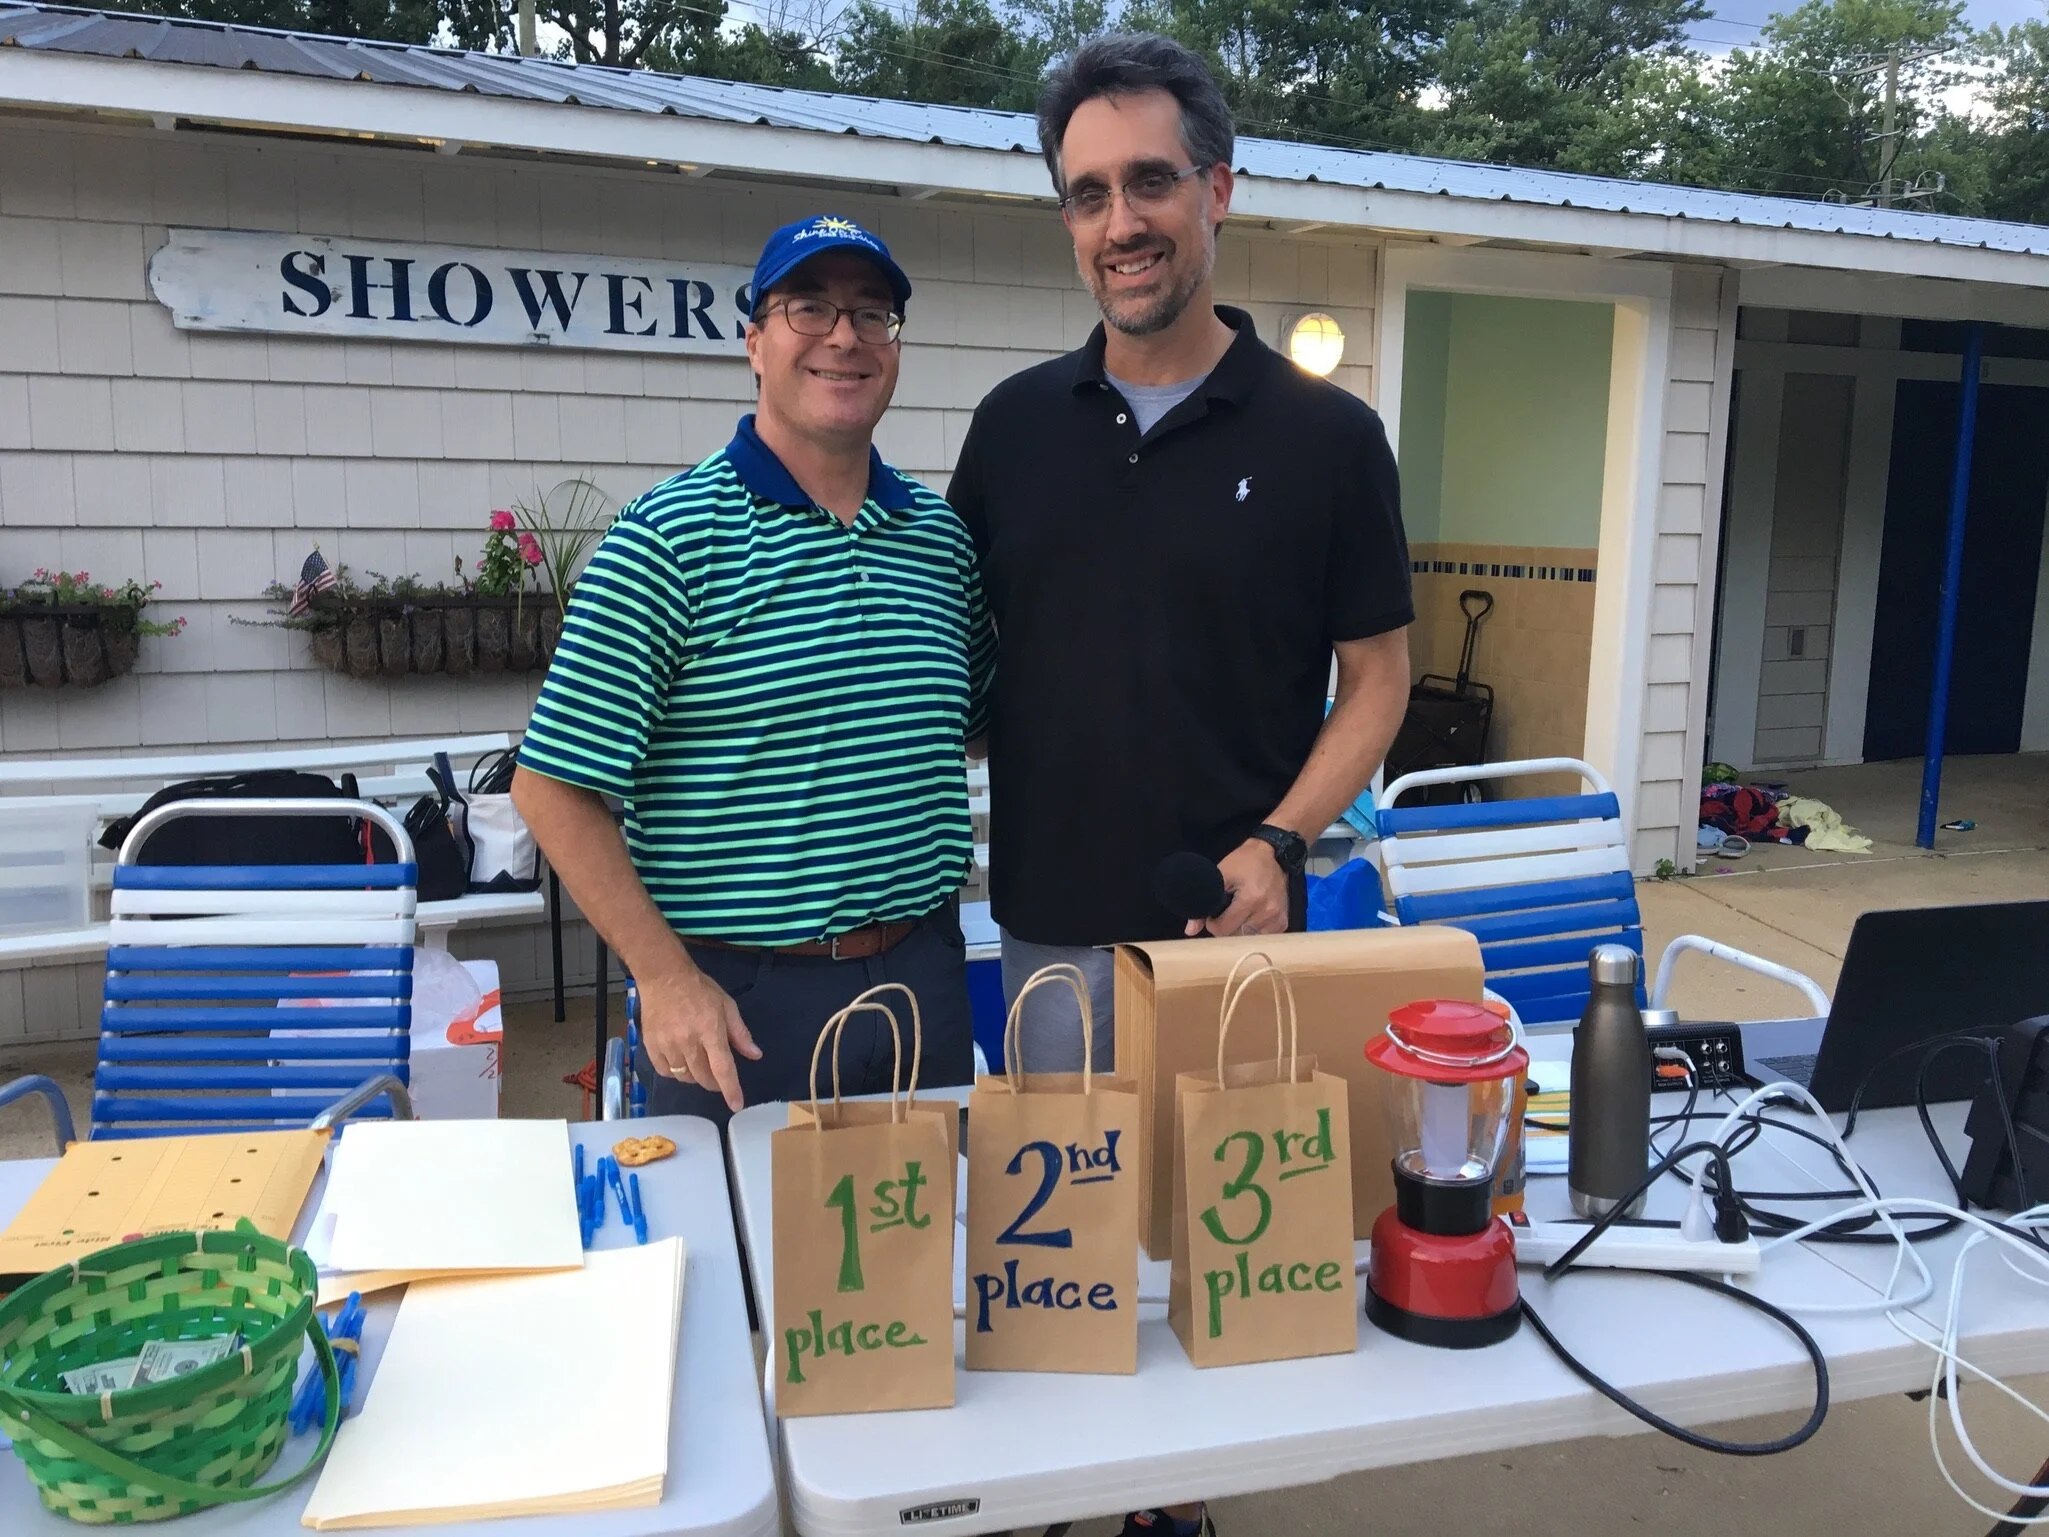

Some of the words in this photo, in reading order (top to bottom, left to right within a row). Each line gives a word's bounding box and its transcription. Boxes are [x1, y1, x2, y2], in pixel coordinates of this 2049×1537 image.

[824, 1161, 931, 1292] 1st
[997, 1130, 1121, 1248] 2nd
[1200, 1108, 1334, 1245] 3rd
[973, 1260, 1118, 1333] place
[1204, 1252, 1343, 1339] place
[785, 1311, 927, 1384] place
